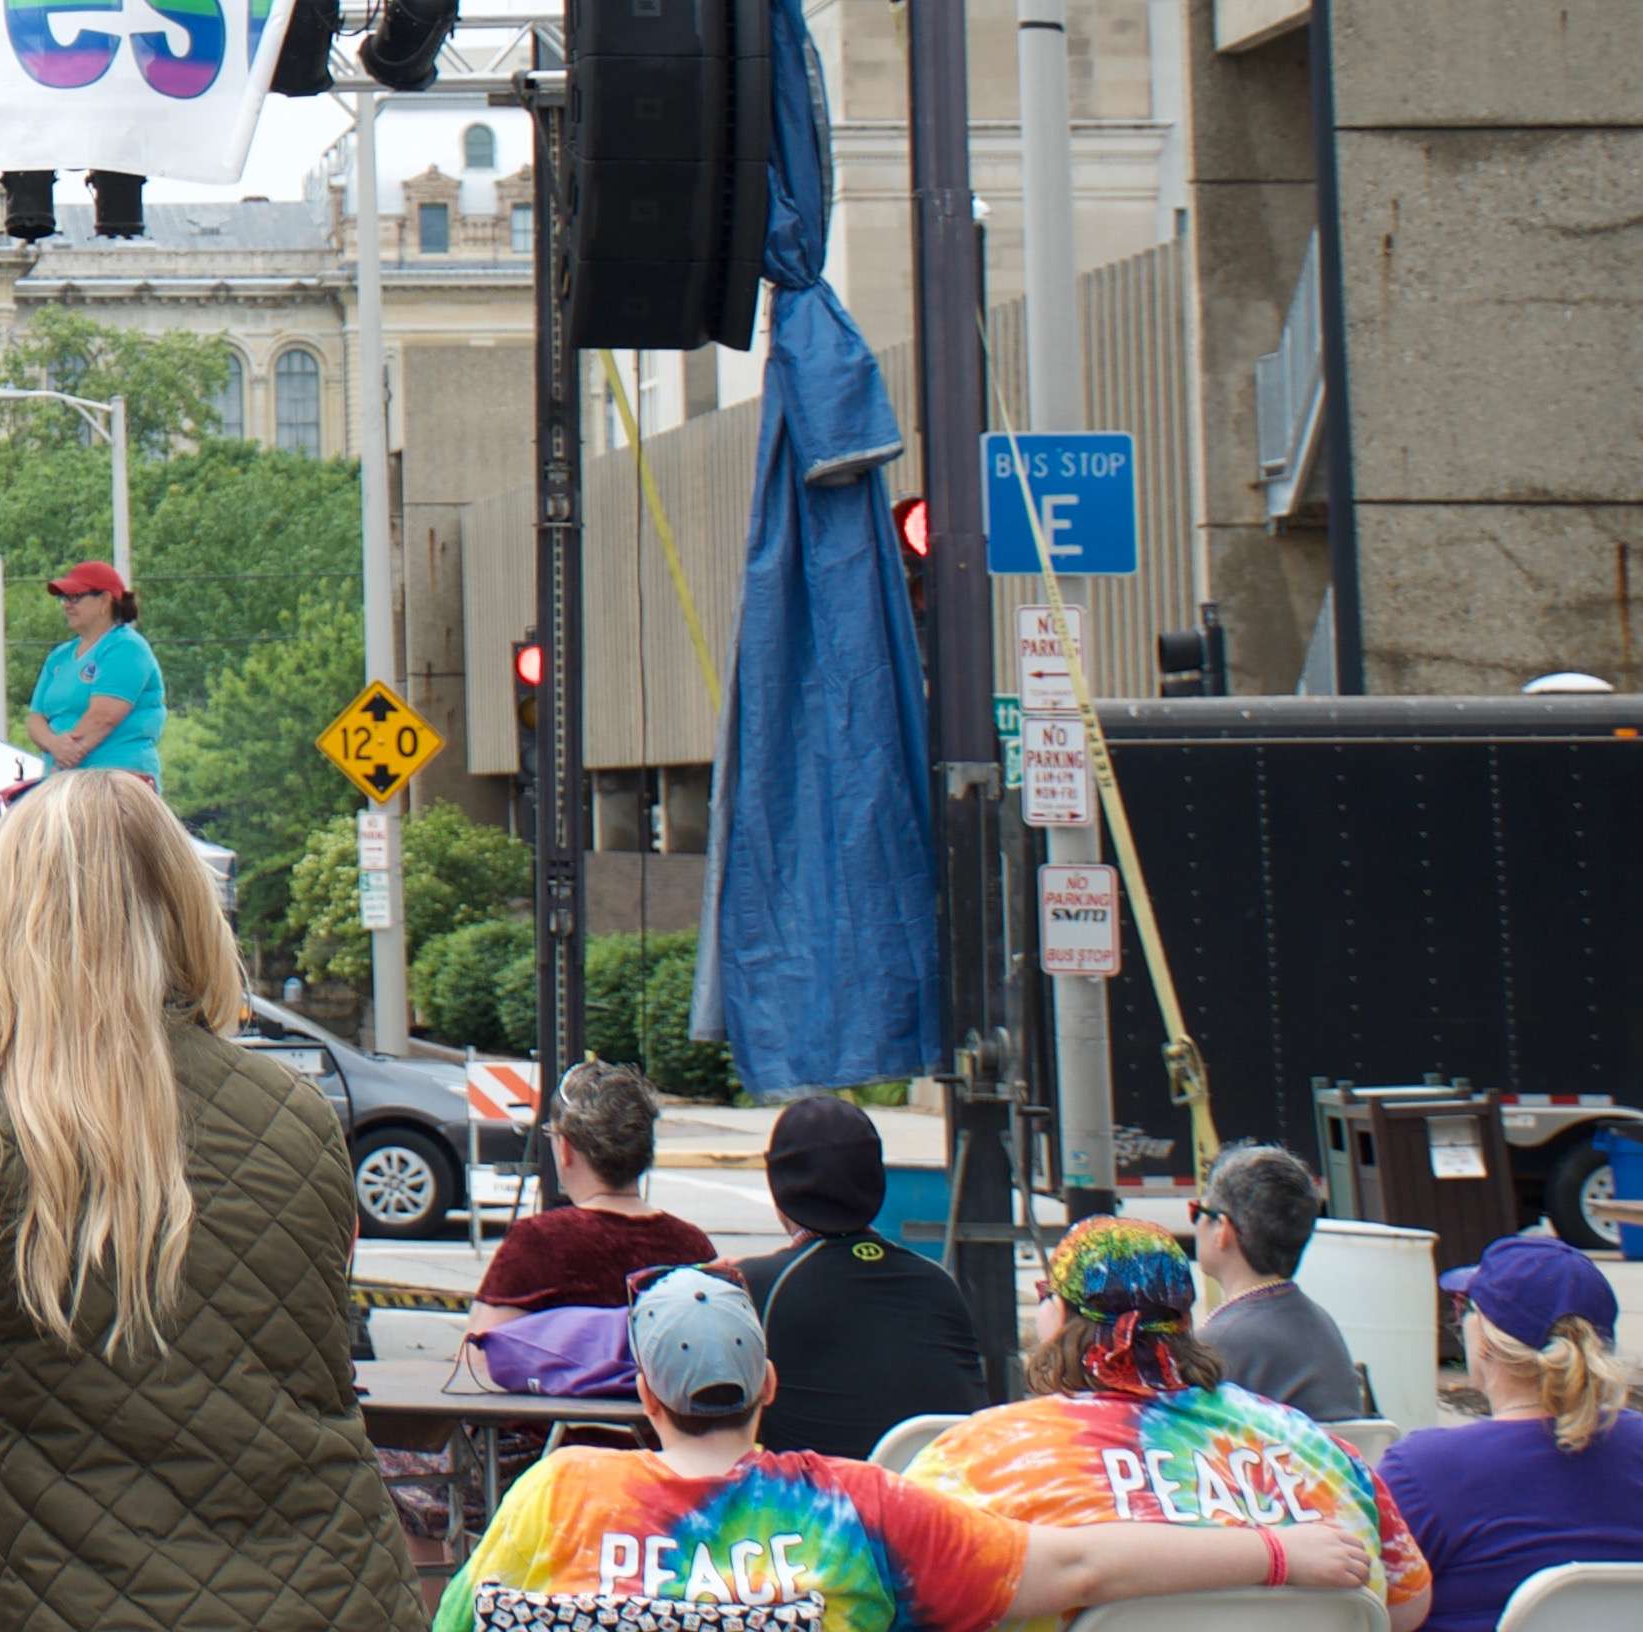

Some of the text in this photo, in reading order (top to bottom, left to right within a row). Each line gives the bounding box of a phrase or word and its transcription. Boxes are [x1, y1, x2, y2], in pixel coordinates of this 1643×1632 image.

[995, 451, 1126, 479] BUS STOP
[1041, 493, 1084, 556] E
[1043, 728, 1068, 746] NO
[1026, 750, 1084, 769] PARKING
[1066, 876, 1089, 890] NO
[1045, 892, 1113, 907] PARKING
[1046, 948, 1113, 963] BUS STOP
[1101, 1443, 1324, 1525] PEACE
[599, 1532, 808, 1606] PEACE
